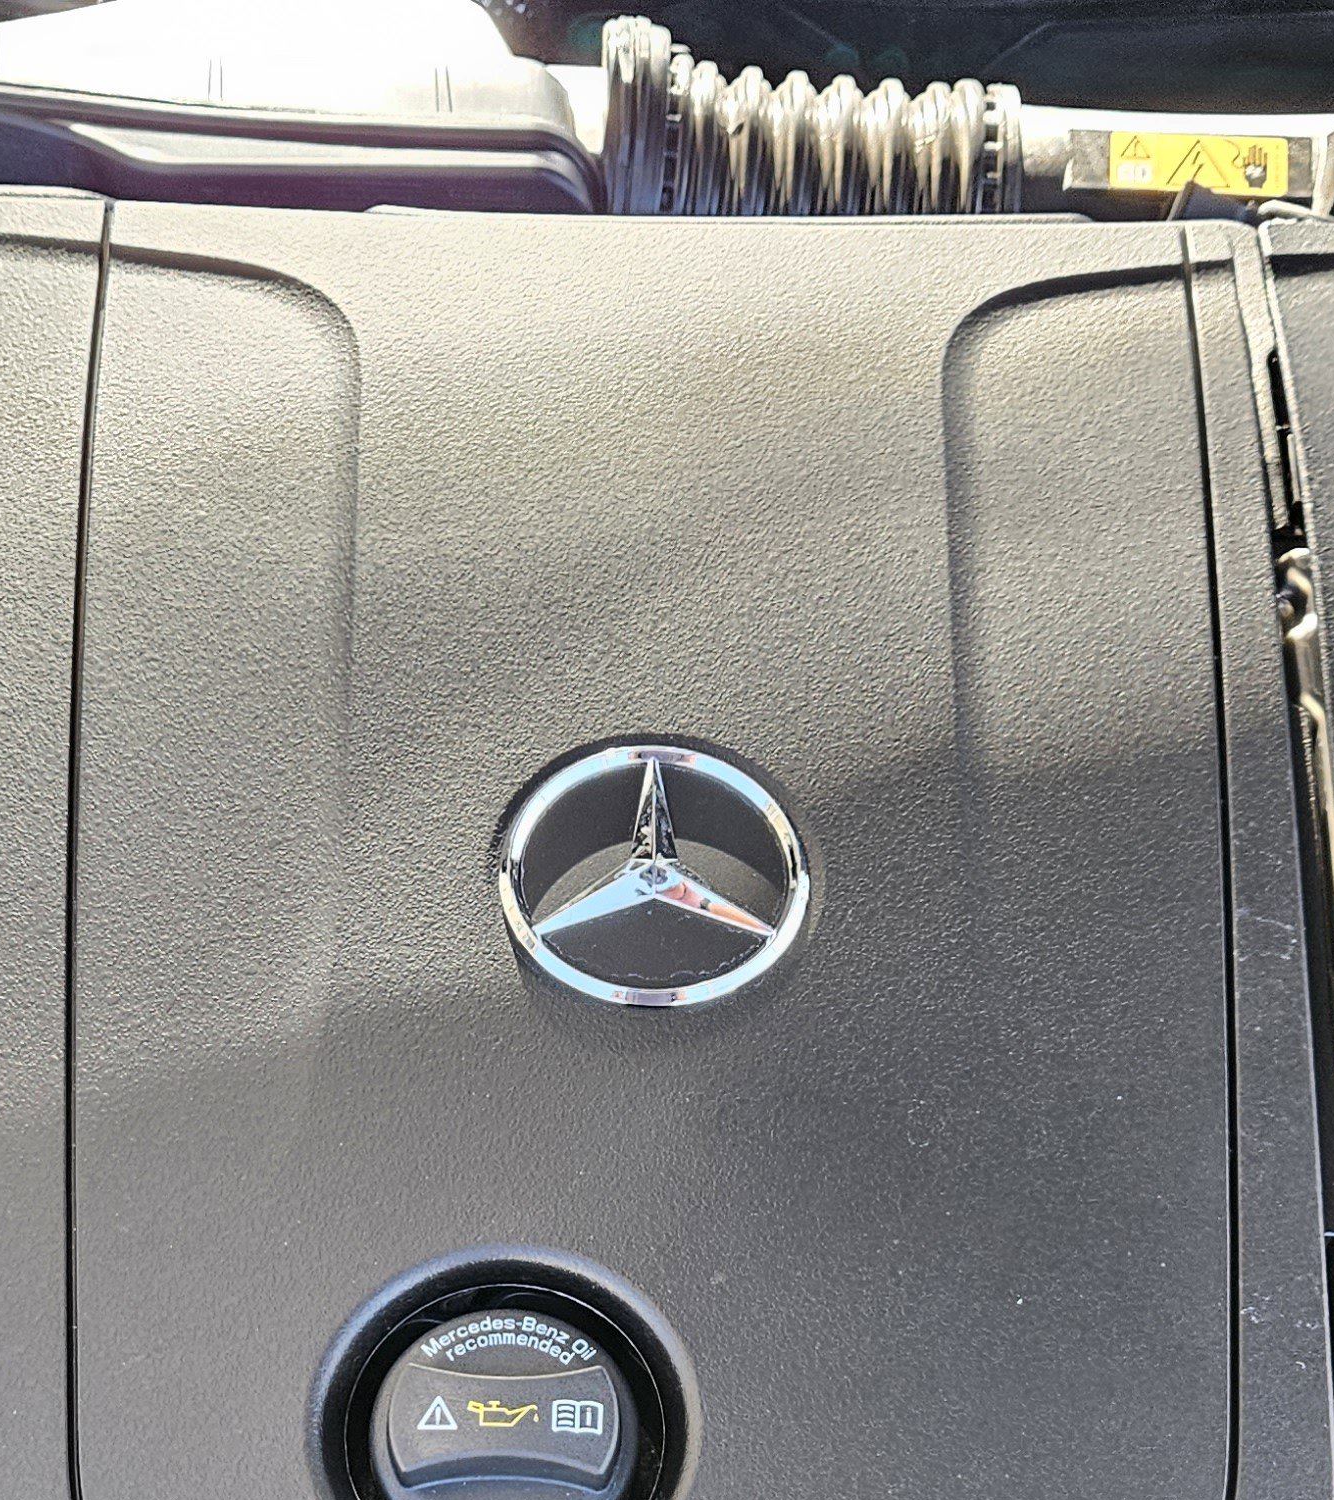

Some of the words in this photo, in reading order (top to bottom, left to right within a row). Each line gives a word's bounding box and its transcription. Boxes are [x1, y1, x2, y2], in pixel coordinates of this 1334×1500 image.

[420, 1315, 569, 1359] Mercedes-Benz
[571, 1336, 598, 1362] Oil
[444, 1331, 577, 1366] recommended
